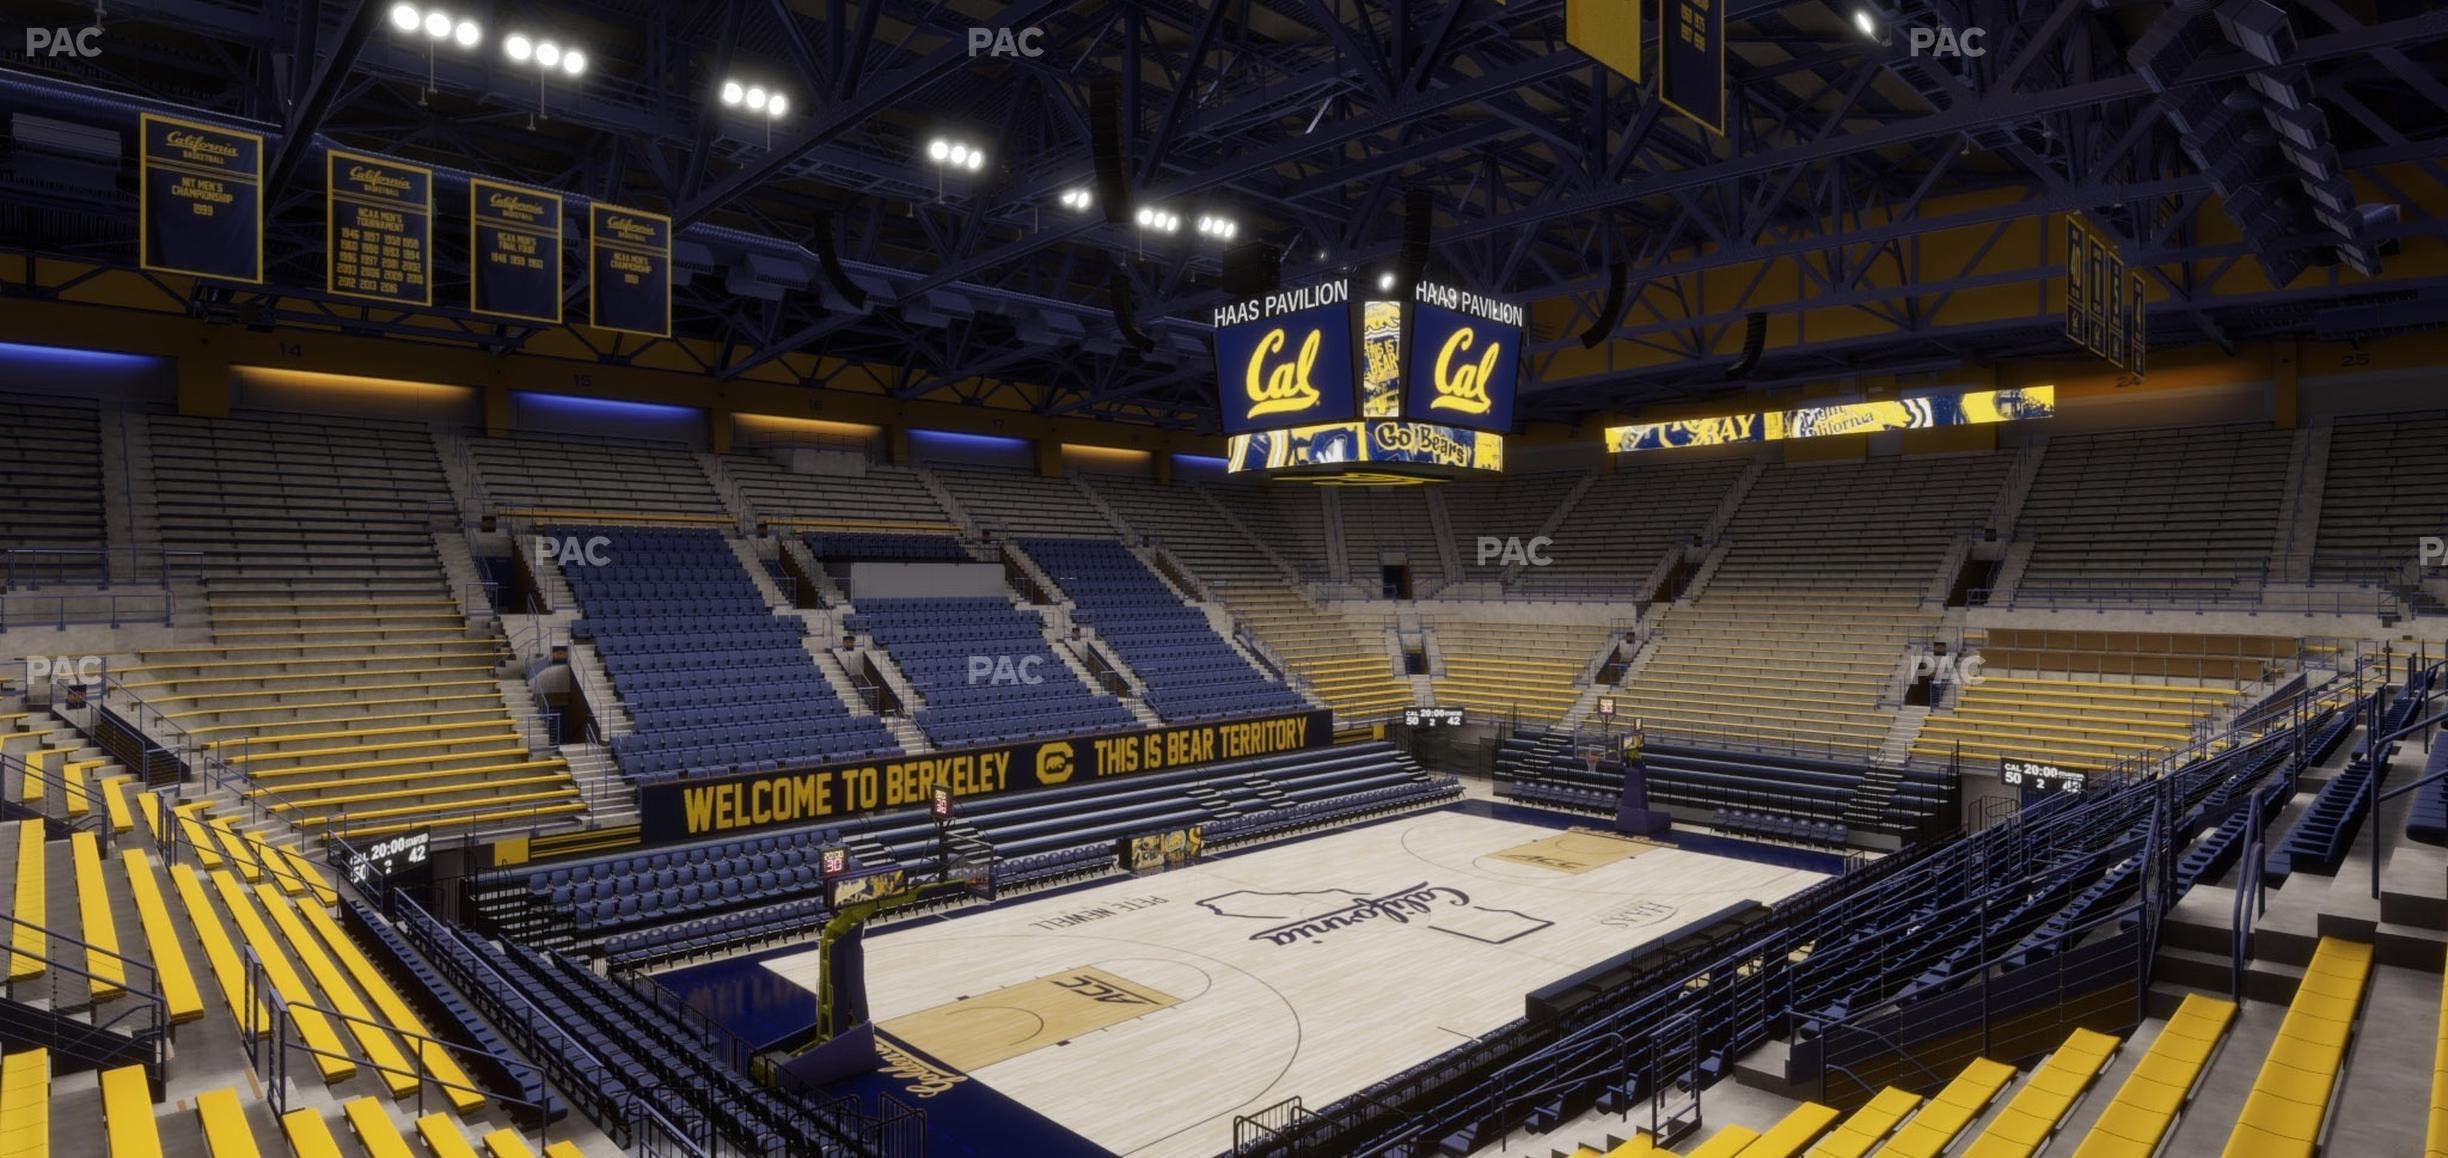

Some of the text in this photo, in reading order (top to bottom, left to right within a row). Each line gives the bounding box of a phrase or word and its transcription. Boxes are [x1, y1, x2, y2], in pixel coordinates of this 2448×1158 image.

[165, 131, 239, 157] California
[182, 150, 225, 165] BASKETBALL
[349, 166, 412, 190] California
[171, 185, 233, 204] CHAMPIONSHIP
[490, 193, 545, 215] California
[356, 216, 404, 232] TOURNAMENT
[606, 216, 656, 236] California
[1214, 279, 1349, 328] HAAS PAVILION
[1415, 280, 1523, 327] HAAS PAVILION
[1246, 327, 1321, 419] Cal
[1430, 327, 1500, 414] Cal
[1377, 423, 1467, 465] Go Bears
[1406, 716, 1461, 727] 50 2 42
[1420, 708, 1445, 718] 20:00
[1095, 717, 1309, 777] THIS IS BEAR TERRITORY
[2004, 763, 2022, 773] CAL
[2024, 763, 2059, 779] 20:00
[2005, 771, 2022, 785] 50
[2036, 778, 2046, 790] 2
[684, 751, 1012, 835] WELCOME TO BERKELEY
[371, 836, 405, 861] 20:00
[408, 844, 427, 863] 42
[825, 858, 843, 873] 30
[1028, 908, 1118, 931] NEWELL
[1249, 881, 1471, 946] California
[1050, 974, 1164, 1006] ACC
